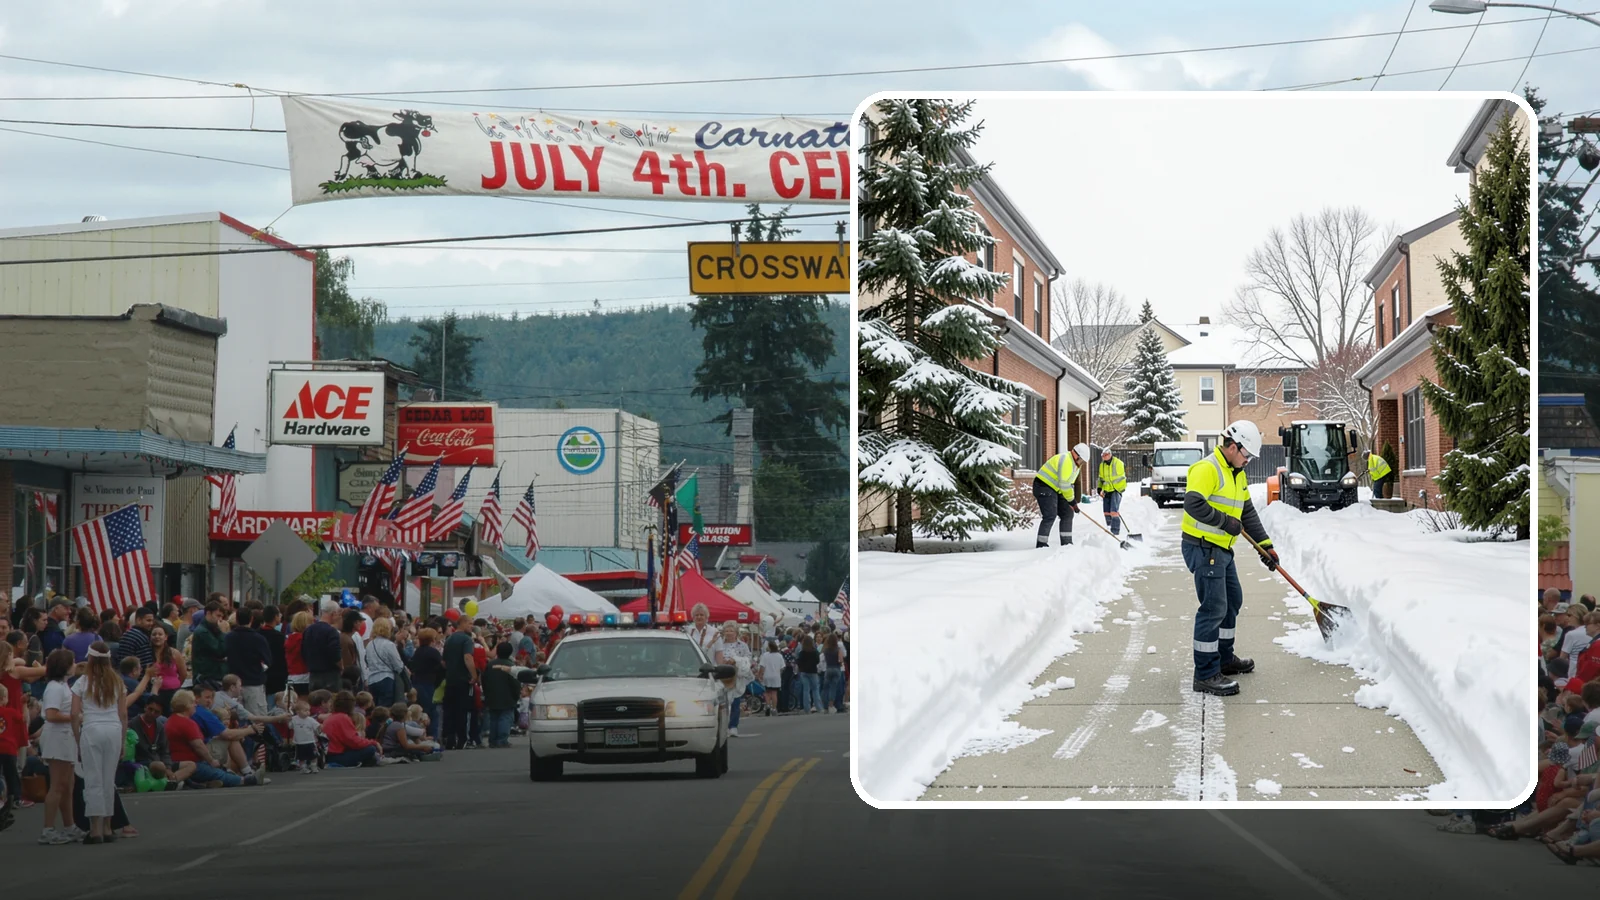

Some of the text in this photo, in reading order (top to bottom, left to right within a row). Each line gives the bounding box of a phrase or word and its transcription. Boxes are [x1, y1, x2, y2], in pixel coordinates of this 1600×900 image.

[695, 121, 850, 149] Carnat
[481, 141, 604, 192] JULY
[632, 150, 746, 198] 4th.
[697, 254, 850, 279] CROSSWA
[283, 380, 373, 420] ACE
[406, 409, 452, 422] CEDAR
[283, 421, 370, 436] Hardware
[416, 428, 477, 447] Coca-Cola
[353, 467, 384, 480] Simpl
[96, 485, 124, 494] Vincent
[126, 485, 136, 494] de
[138, 486, 155, 495] Paul
[81, 503, 153, 522] THT
[213, 516, 330, 535] HARDARE
[688, 526, 741, 535] CRNATION
[700, 535, 730, 543] GLASS
